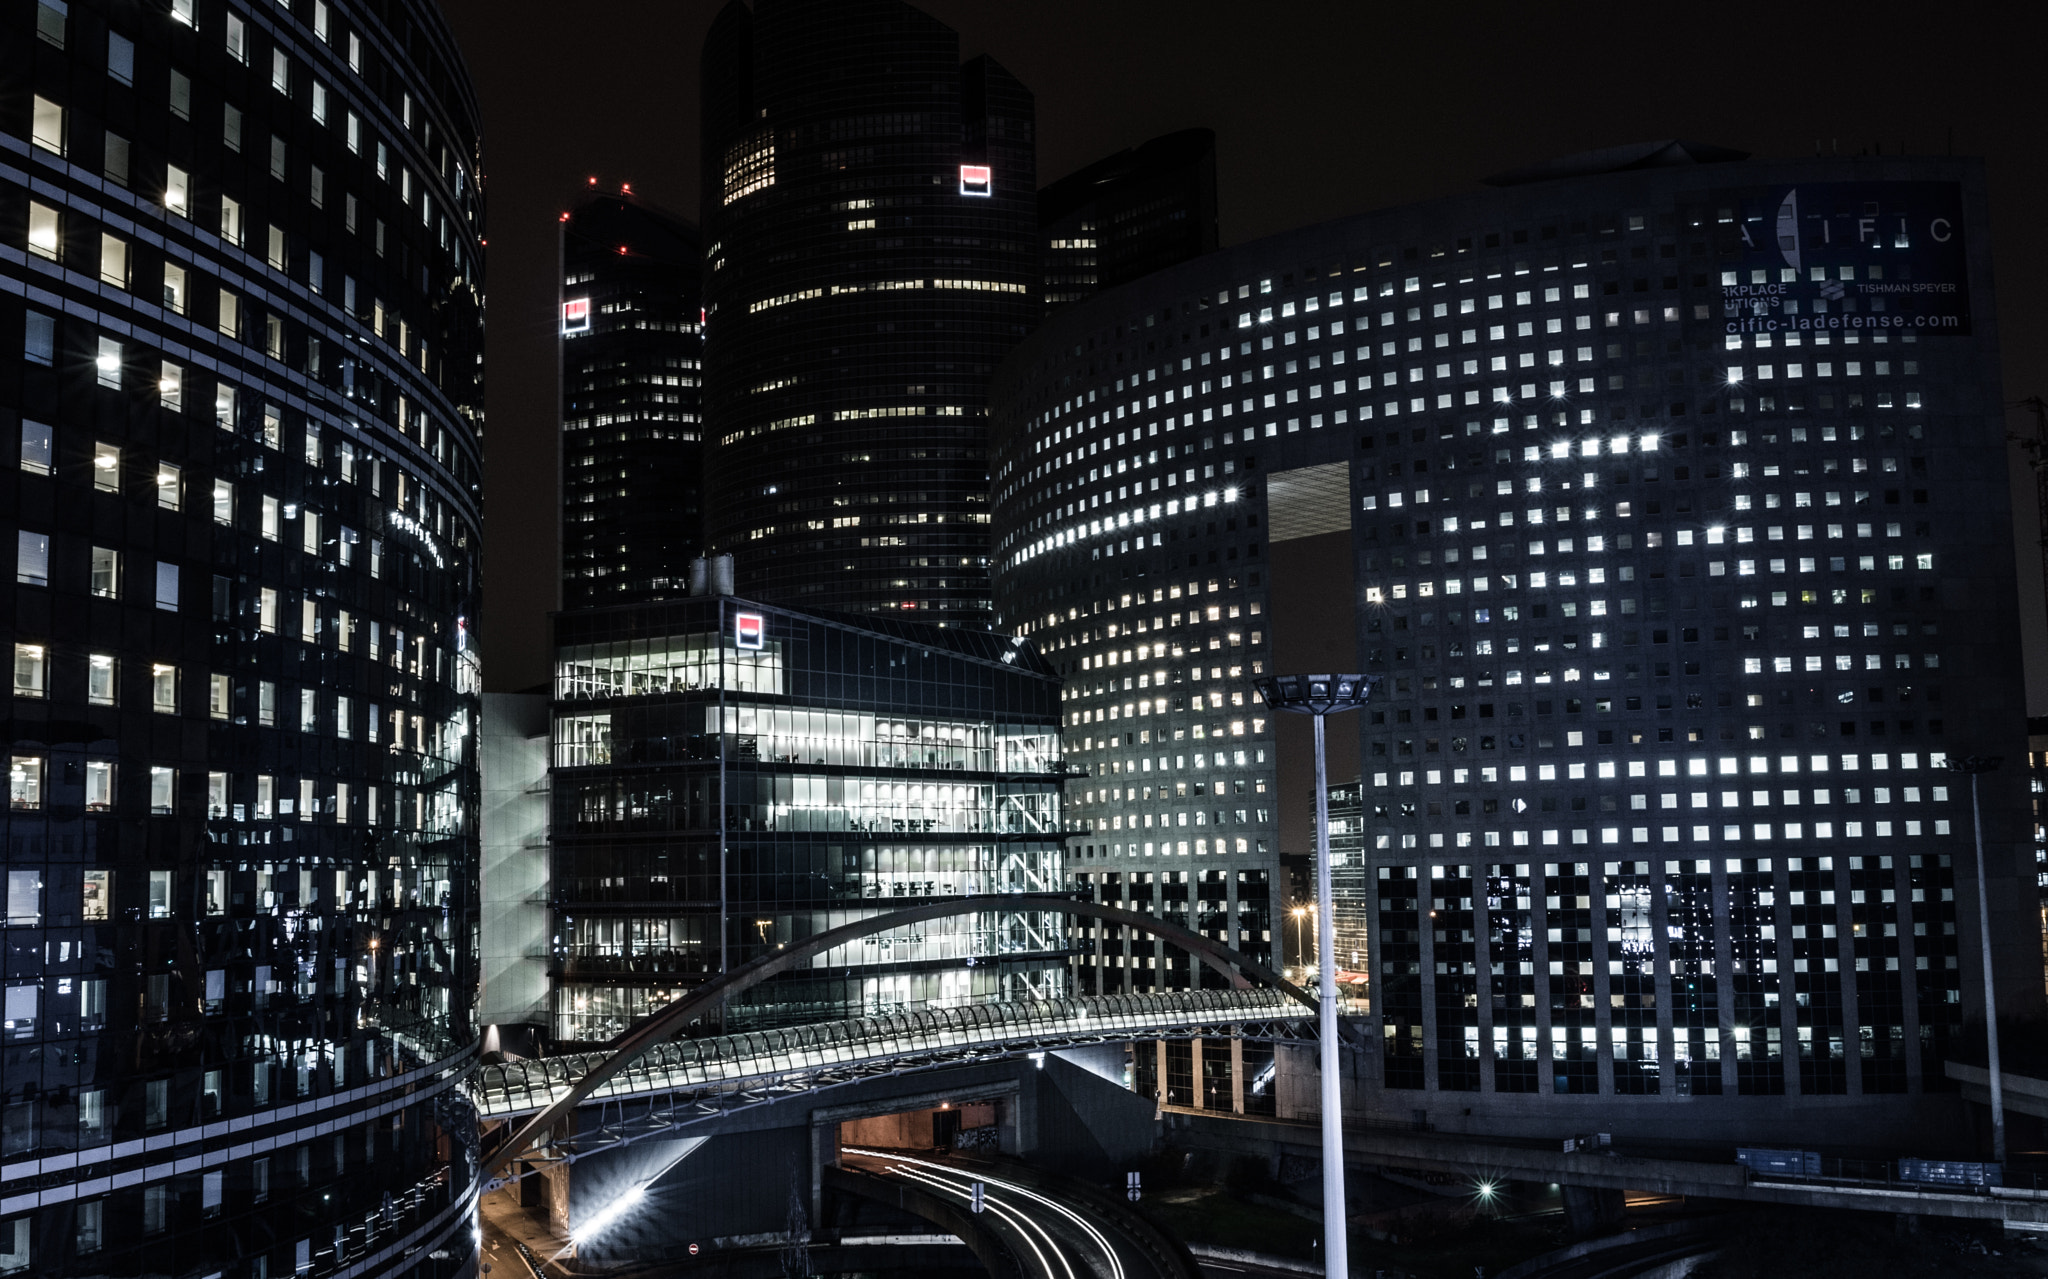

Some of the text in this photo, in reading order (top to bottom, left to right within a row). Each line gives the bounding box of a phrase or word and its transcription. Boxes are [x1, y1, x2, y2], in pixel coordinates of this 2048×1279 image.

[1857, 283, 1957, 294] TISHMAN SPEYER
[1726, 314, 1959, 332] cific-ladefense.com
